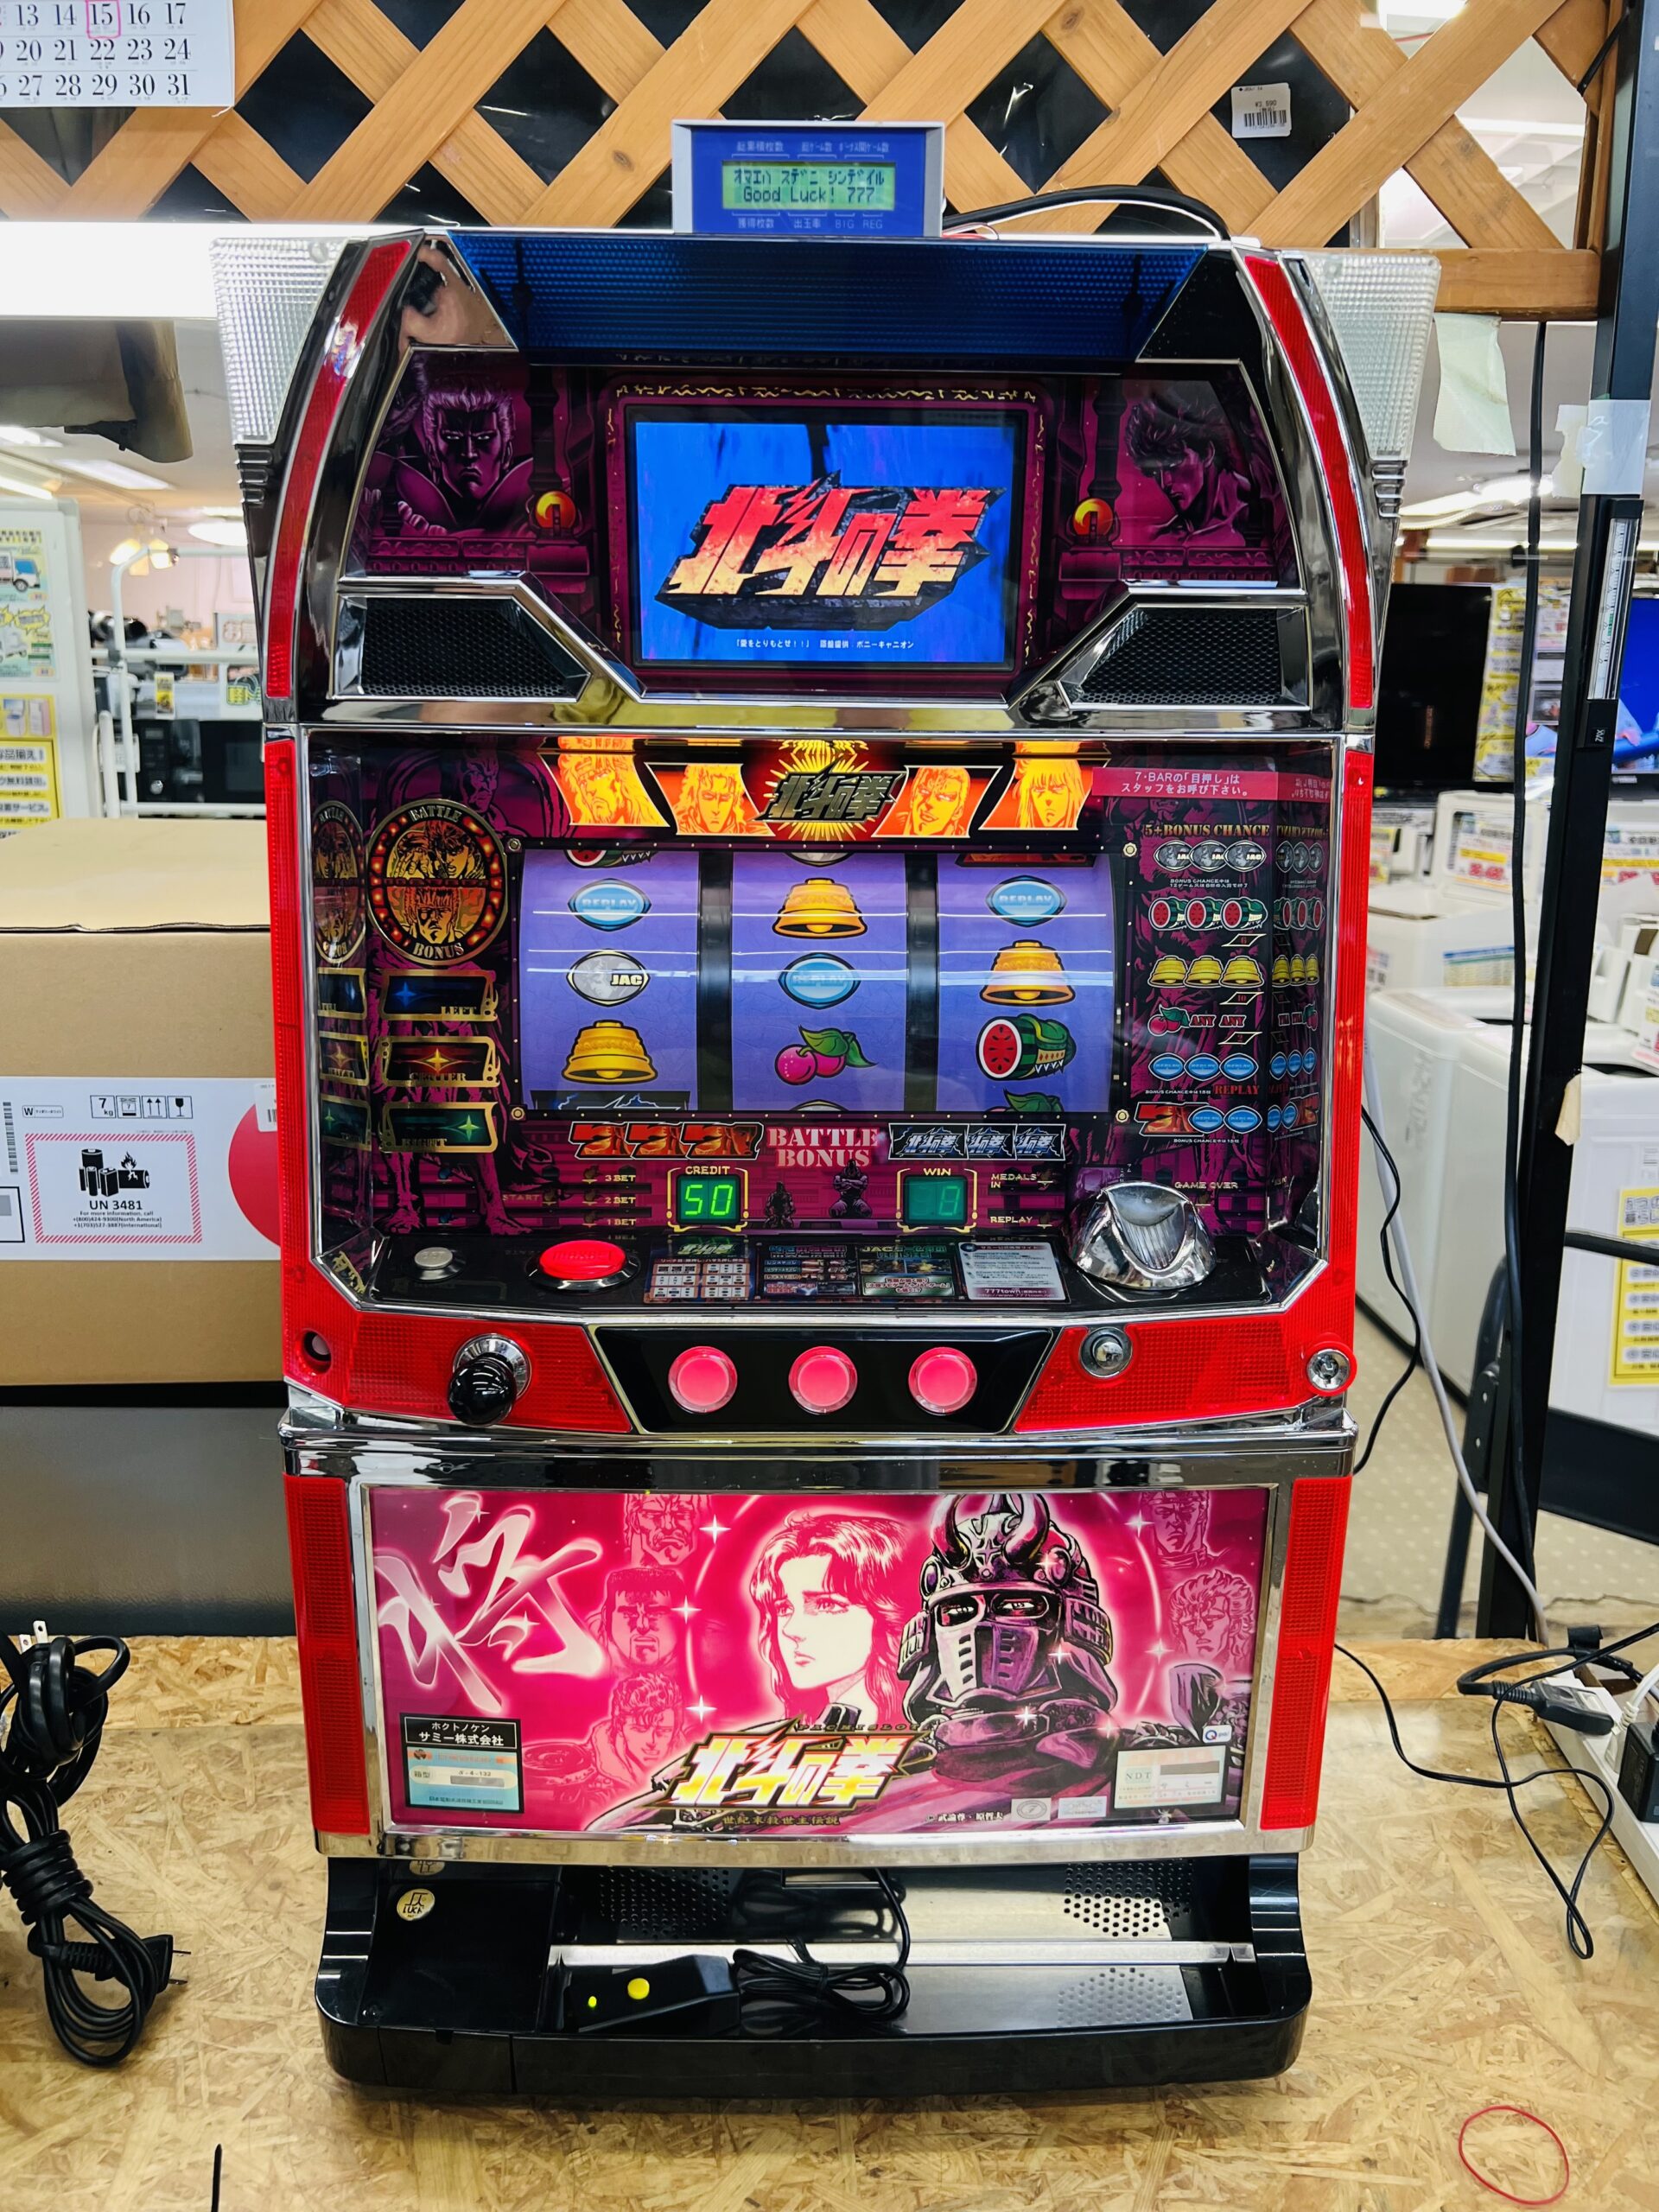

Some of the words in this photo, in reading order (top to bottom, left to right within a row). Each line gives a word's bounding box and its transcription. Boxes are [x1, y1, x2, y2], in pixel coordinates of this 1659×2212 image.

[16, 3, 39, 26] 13
[54, 3, 77, 26] 14
[90, 3, 113, 25] 15
[128, 3, 150, 25] 16
[165, 3, 186, 25] 17
[16, 40, 41, 60] 20
[54, 40, 78, 60] 21
[90, 39, 115, 60] 22
[128, 38, 153, 60] 23
[164, 38, 191, 60] 24
[19, 74, 42, 97] 27
[55, 74, 81, 97] 28
[92, 74, 118, 97] 29
[130, 73, 156, 97] 30
[168, 73, 191, 97] 31
[743, 187, 781, 203] Good
[790, 187, 835, 203] Luck!
[848, 188, 875, 203] 777
[835, 219, 855, 229] BIG
[862, 219, 883, 229] REG
[664, 479, 991, 596] 北斗の拳
[1121, 783, 1248, 797] スタッフをお呼び下さい。
[767, 774, 893, 819] 北斗の拳
[409, 804, 464, 823] BATTLE
[1213, 823, 1270, 837] CHANCE
[999, 894, 1052, 906] REPLAY
[413, 943, 464, 959] BONUS
[610, 974, 643, 987] JAC
[441, 1007, 477, 1015] LEFT
[1191, 1015, 1214, 1027] ANY
[1221, 1015, 1245, 1027] ANY
[409, 1072, 467, 1081] CENTER
[1213, 1084, 1260, 1096] REPLAY
[98, 1097, 107, 1109] 7
[23, 1107, 34, 1116] W
[402, 1138, 448, 1147] RIGHT
[766, 1127, 878, 1147] BATTLE
[777, 1149, 871, 1167] BONUS
[684, 1166, 730, 1175] CREDIT
[923, 1167, 951, 1176] WIN
[613, 1173, 636, 1182] BET
[991, 1173, 1037, 1181] MEDALS
[502, 1193, 541, 1202] START
[684, 1184, 733, 1216] 50
[89, 1200, 109, 1210] UN
[112, 1200, 143, 1210] 3481
[432, 1721, 490, 1733] ホクトノケン
[418, 1731, 504, 1746] サミー株式会社
[670, 1731, 916, 1807] 北斗の拳
[721, 1815, 841, 1826] 世紀末救世主伝説
